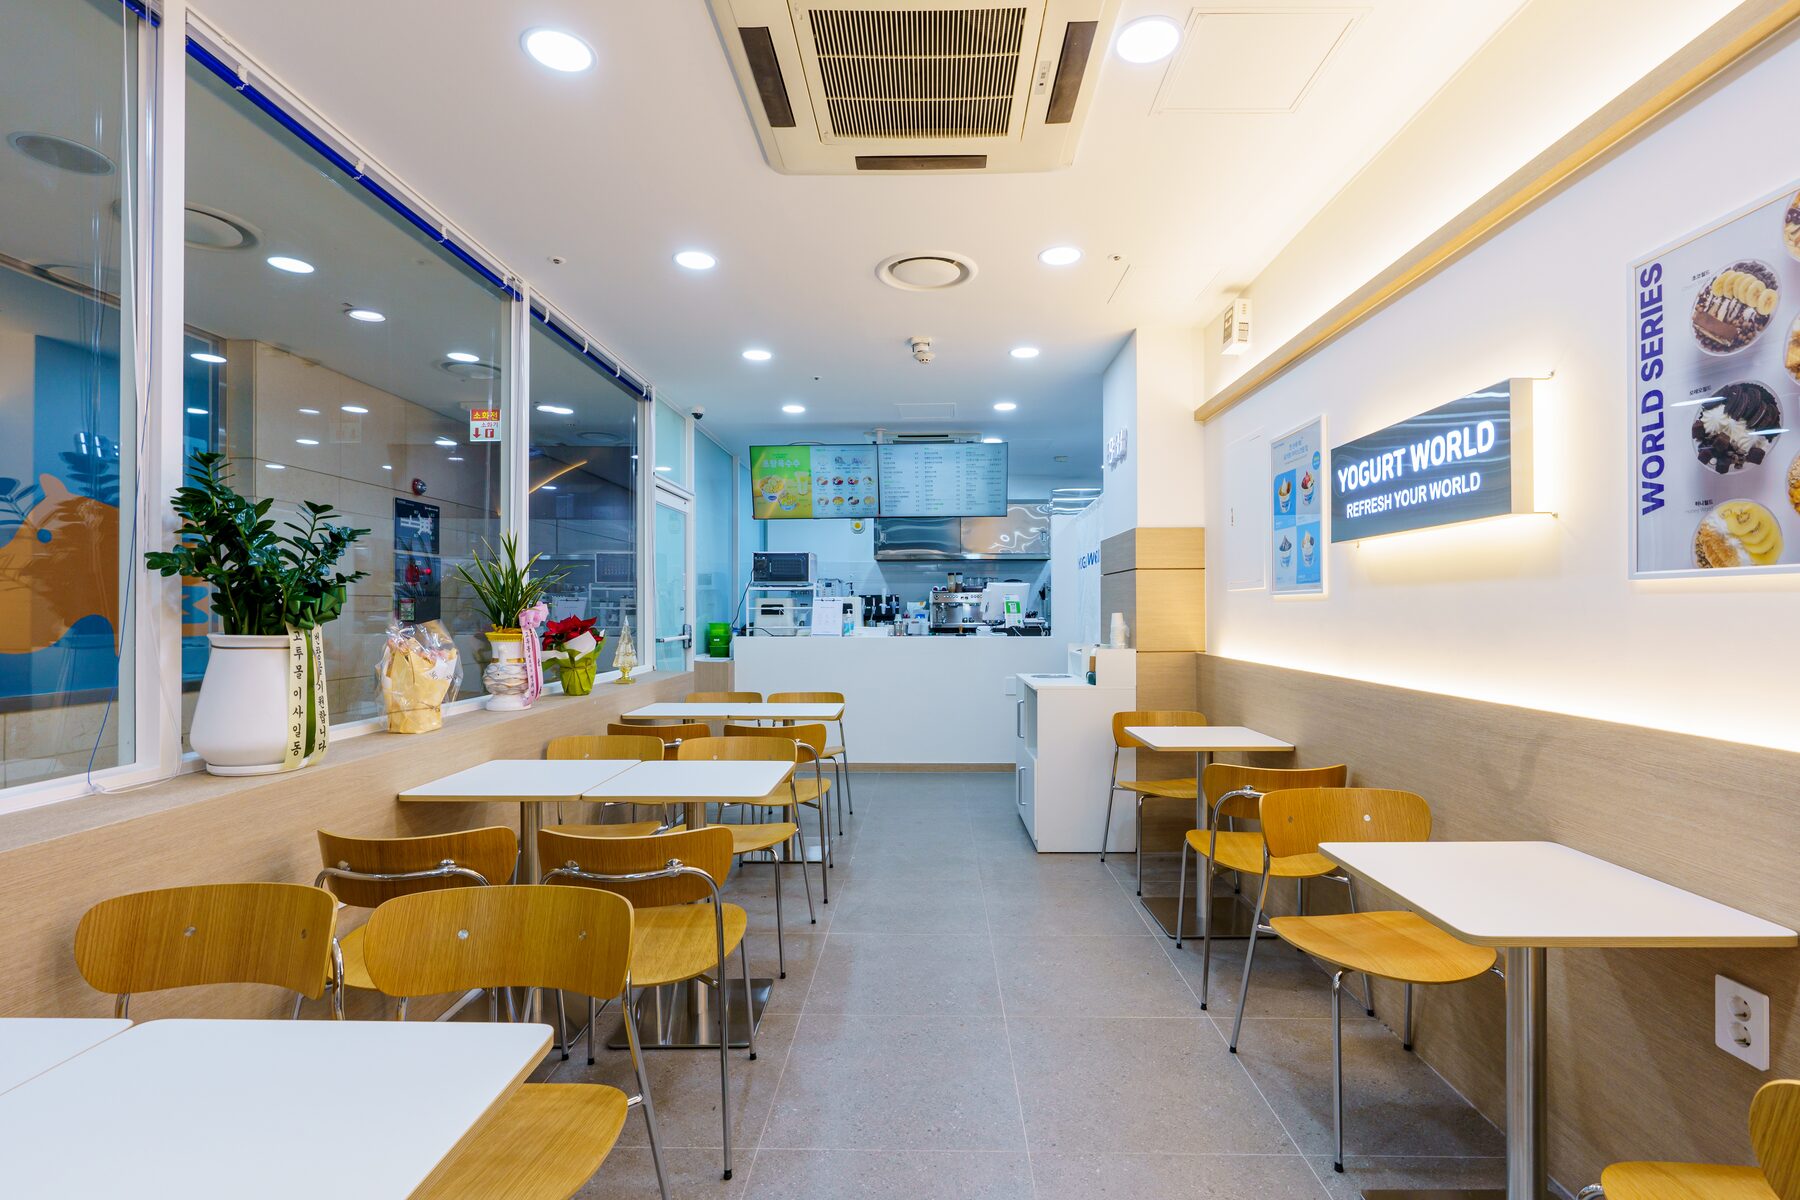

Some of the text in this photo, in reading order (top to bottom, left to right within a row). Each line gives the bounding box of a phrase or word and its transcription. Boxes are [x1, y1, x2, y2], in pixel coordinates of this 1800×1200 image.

[473, 411, 499, 420] 소화전
[1639, 262, 1665, 516] WORLD SERIES
[1337, 420, 1495, 493] YOGURT WORLD
[1346, 471, 1481, 519] REFRESH YOUR WORLD
